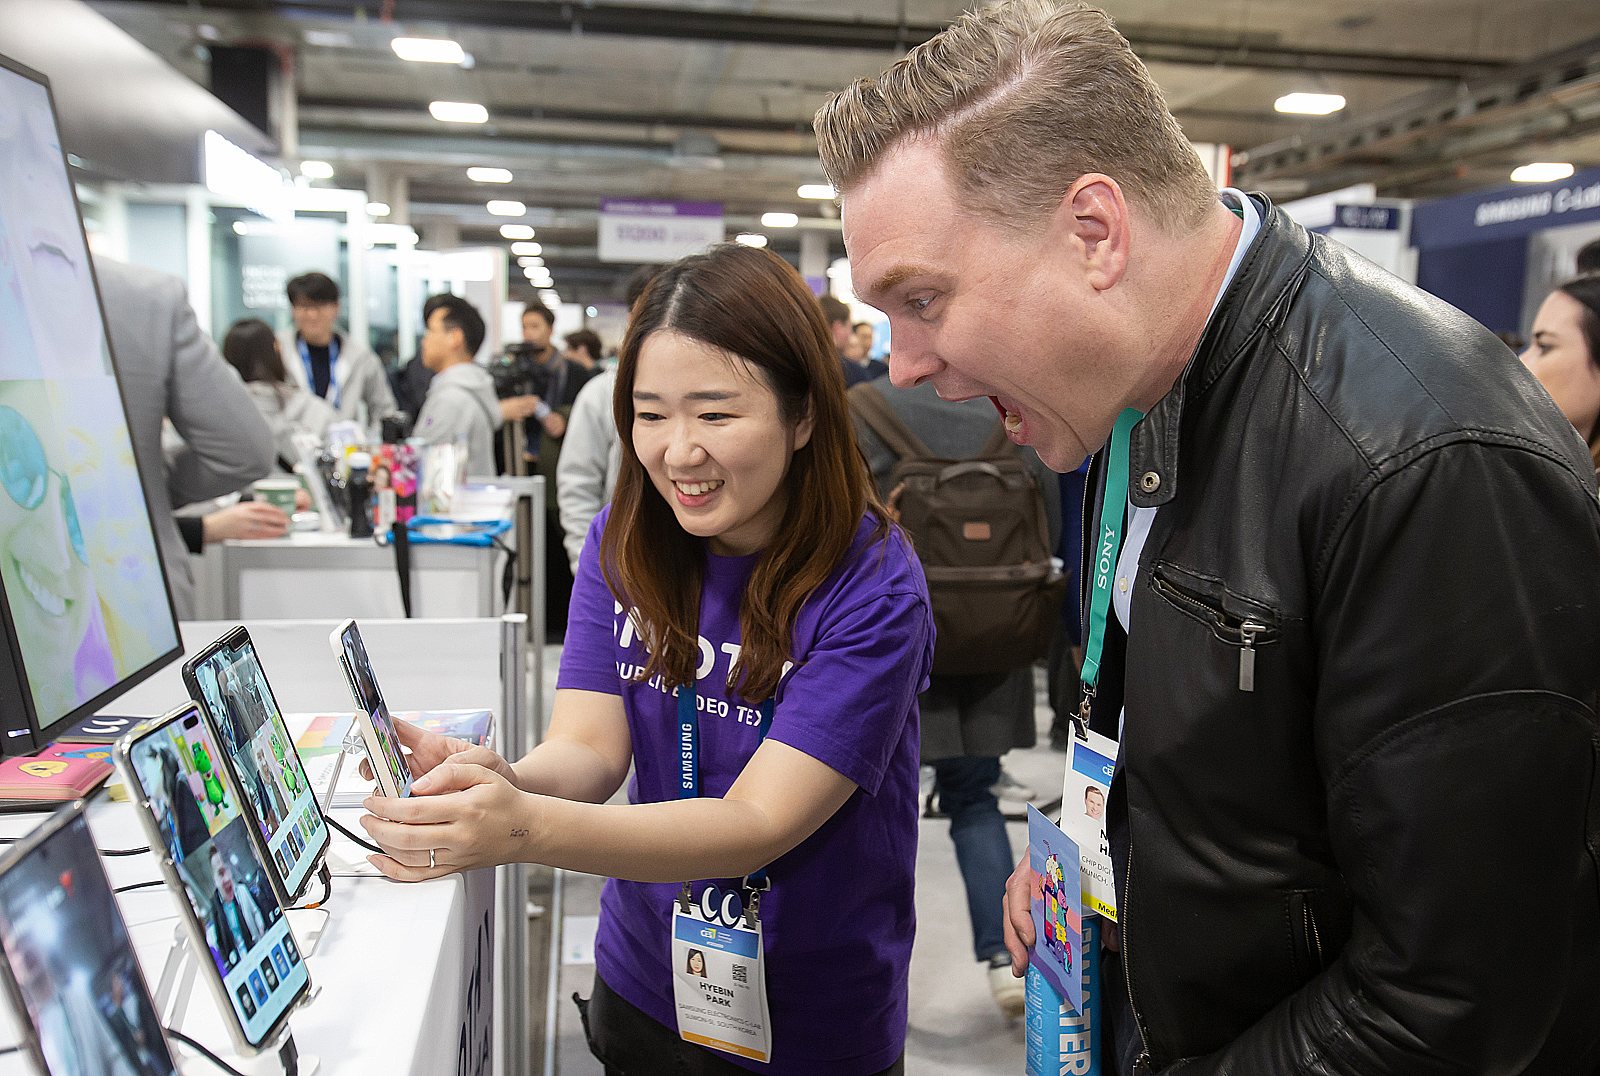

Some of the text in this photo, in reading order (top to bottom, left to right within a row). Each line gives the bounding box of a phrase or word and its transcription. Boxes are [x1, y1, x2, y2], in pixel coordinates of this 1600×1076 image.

[1097, 524, 1115, 590] SONY
[681, 723, 693, 790] SAMSUNG
[1081, 855, 1098, 867] CHIP
[699, 981, 735, 999] HYEBIN
[705, 994, 732, 1008] PARK
